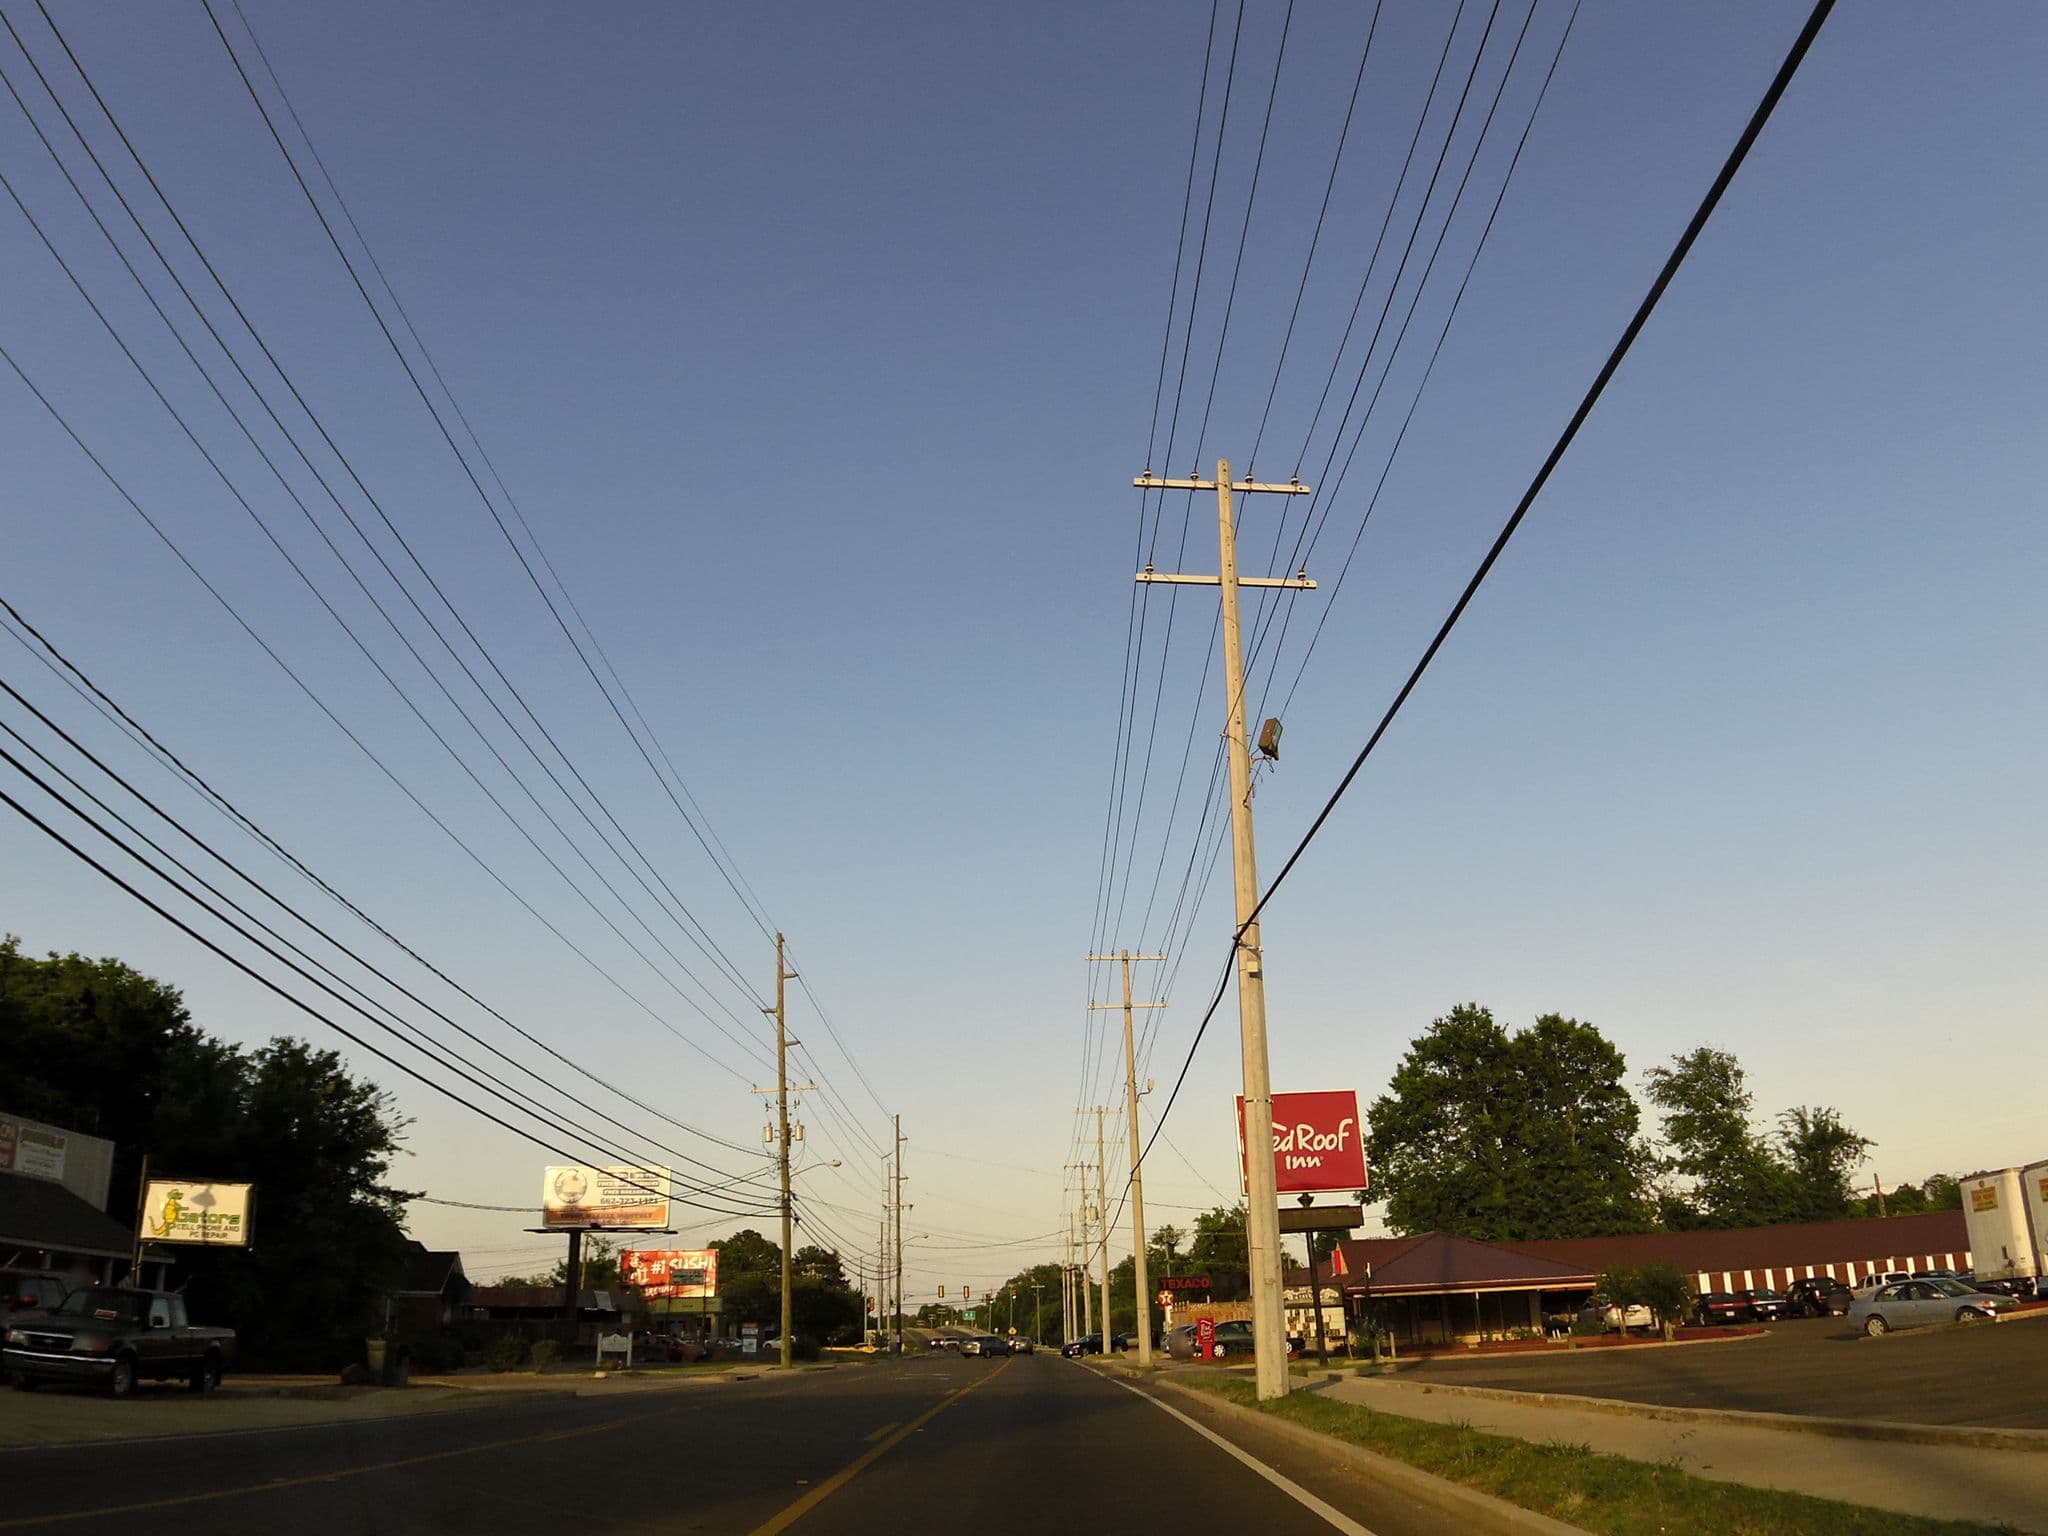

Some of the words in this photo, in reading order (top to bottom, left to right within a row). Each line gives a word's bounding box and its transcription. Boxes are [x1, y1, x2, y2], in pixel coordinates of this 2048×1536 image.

[1296, 1118, 1353, 1152] Roof
[176, 1211, 240, 1225] Gators
[197, 1224, 223, 1232] PHONE
[669, 1256, 714, 1269] SUSHI
[1161, 1278, 1210, 1289] TEXACO
